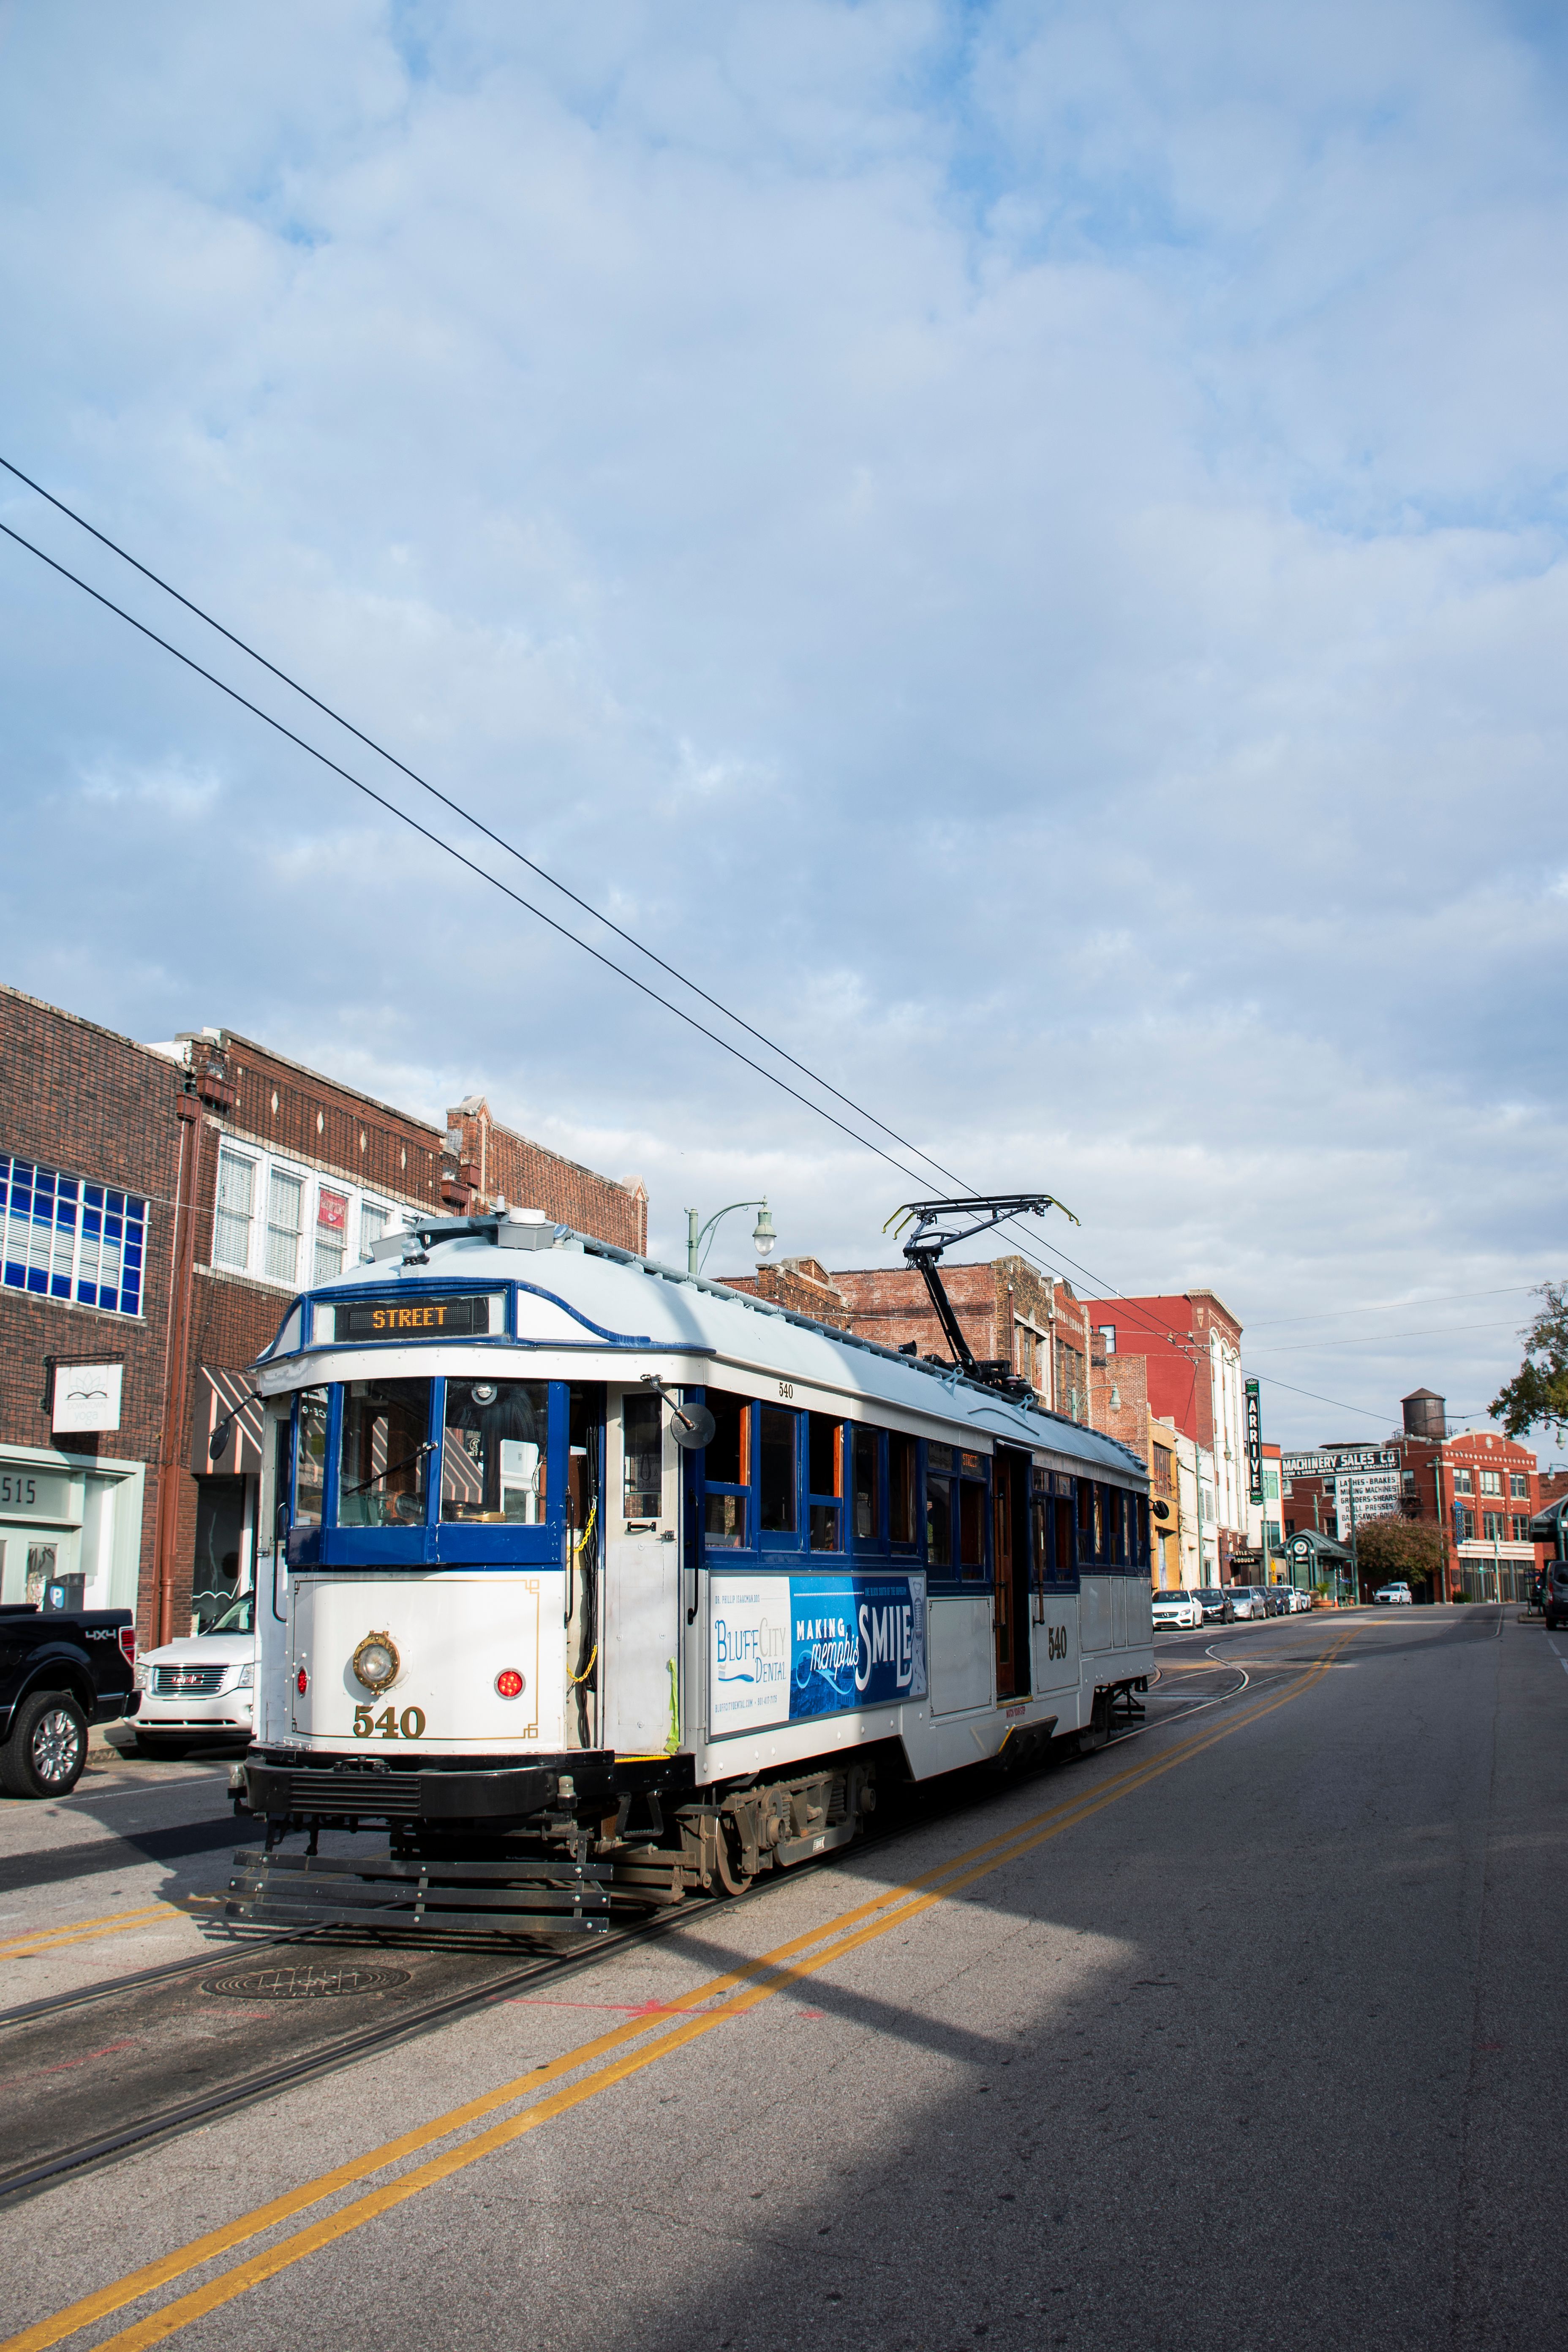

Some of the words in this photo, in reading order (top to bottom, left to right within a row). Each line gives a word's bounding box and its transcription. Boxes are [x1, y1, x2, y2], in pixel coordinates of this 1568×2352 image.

[372, 1307, 448, 1329] STREET
[779, 1382, 793, 1399] 540
[67, 1402, 106, 1410] DOWNTOWN
[74, 1411, 98, 1426] yoga
[1249, 1399, 1260, 1487] ARRIVE
[1282, 1456, 1337, 1471] MACHINERY
[1341, 1453, 1375, 1467] SALES
[1380, 1451, 1398, 1463] CO.
[2, 1477, 35, 1504] 515
[1365, 1486, 1397, 1494] MACHINES
[1341, 1496, 1371, 1504] GRDERS
[1365, 1503, 1394, 1511] PRESSES
[1342, 1513, 1377, 1521] BADSAWS
[52, 1588, 62, 1604] P
[722, 1595, 735, 1603] PHILLIP
[797, 1618, 845, 1641] MAKING
[855, 1604, 912, 1690] SMILE
[1048, 1625, 1067, 1661] 540
[810, 1632, 859, 1680] memphis
[755, 1657, 787, 1683] DENTAL
[172, 1674, 204, 1684] GMC
[715, 1699, 753, 1713] BLUFFCITYDENTAL.COM
[353, 1705, 426, 1738] 540
